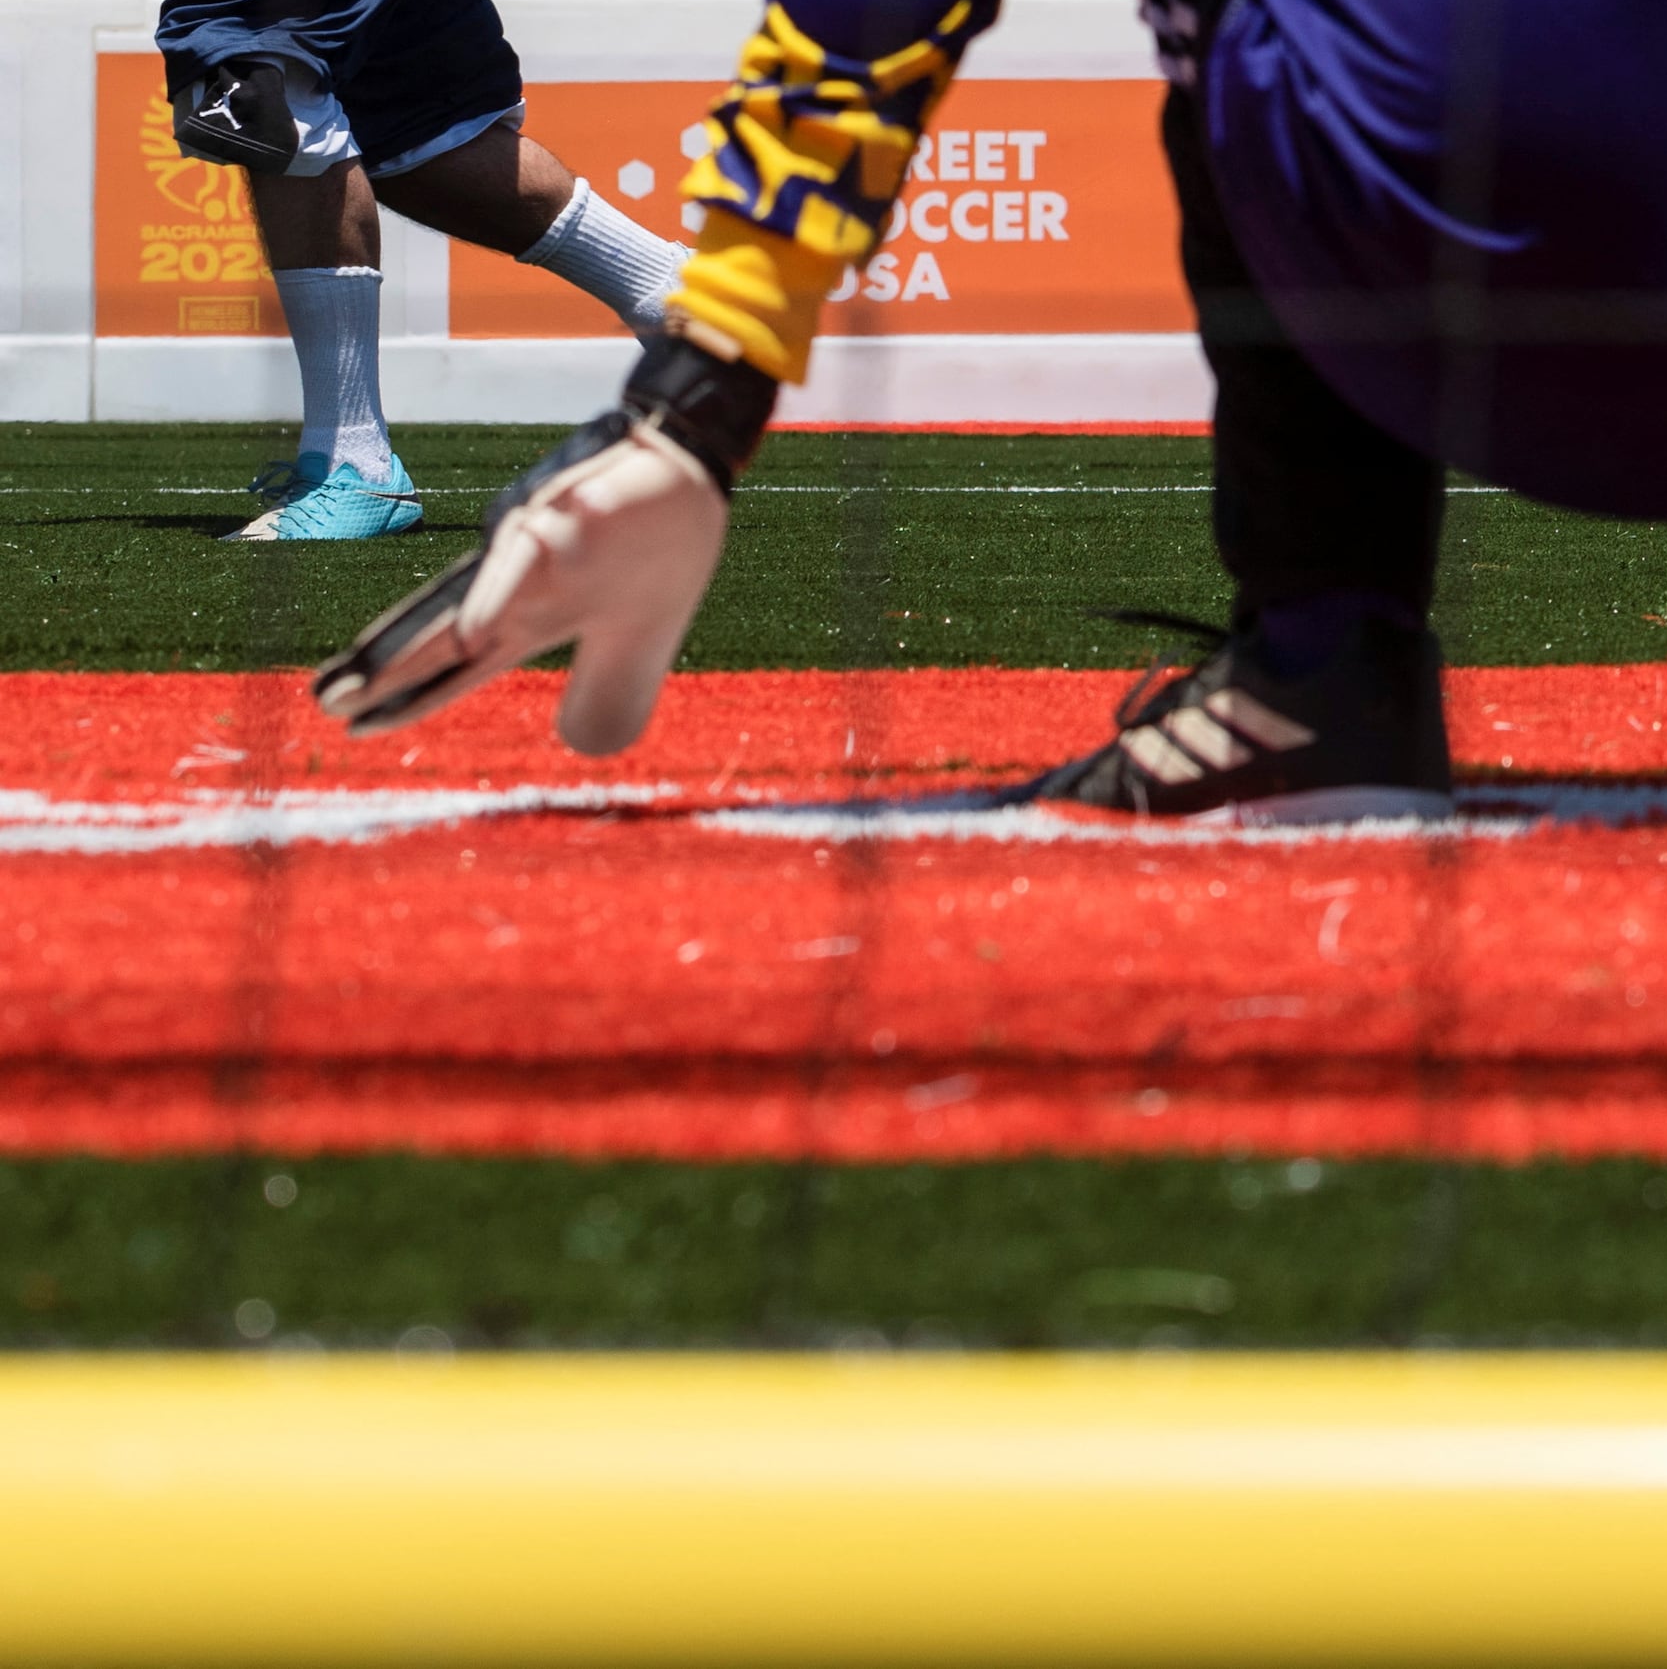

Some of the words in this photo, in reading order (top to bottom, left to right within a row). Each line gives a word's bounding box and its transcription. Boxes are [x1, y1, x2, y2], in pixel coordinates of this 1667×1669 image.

[904, 130, 1047, 181] REET
[882, 190, 1070, 243] CCER
[139, 242, 275, 283] 202
